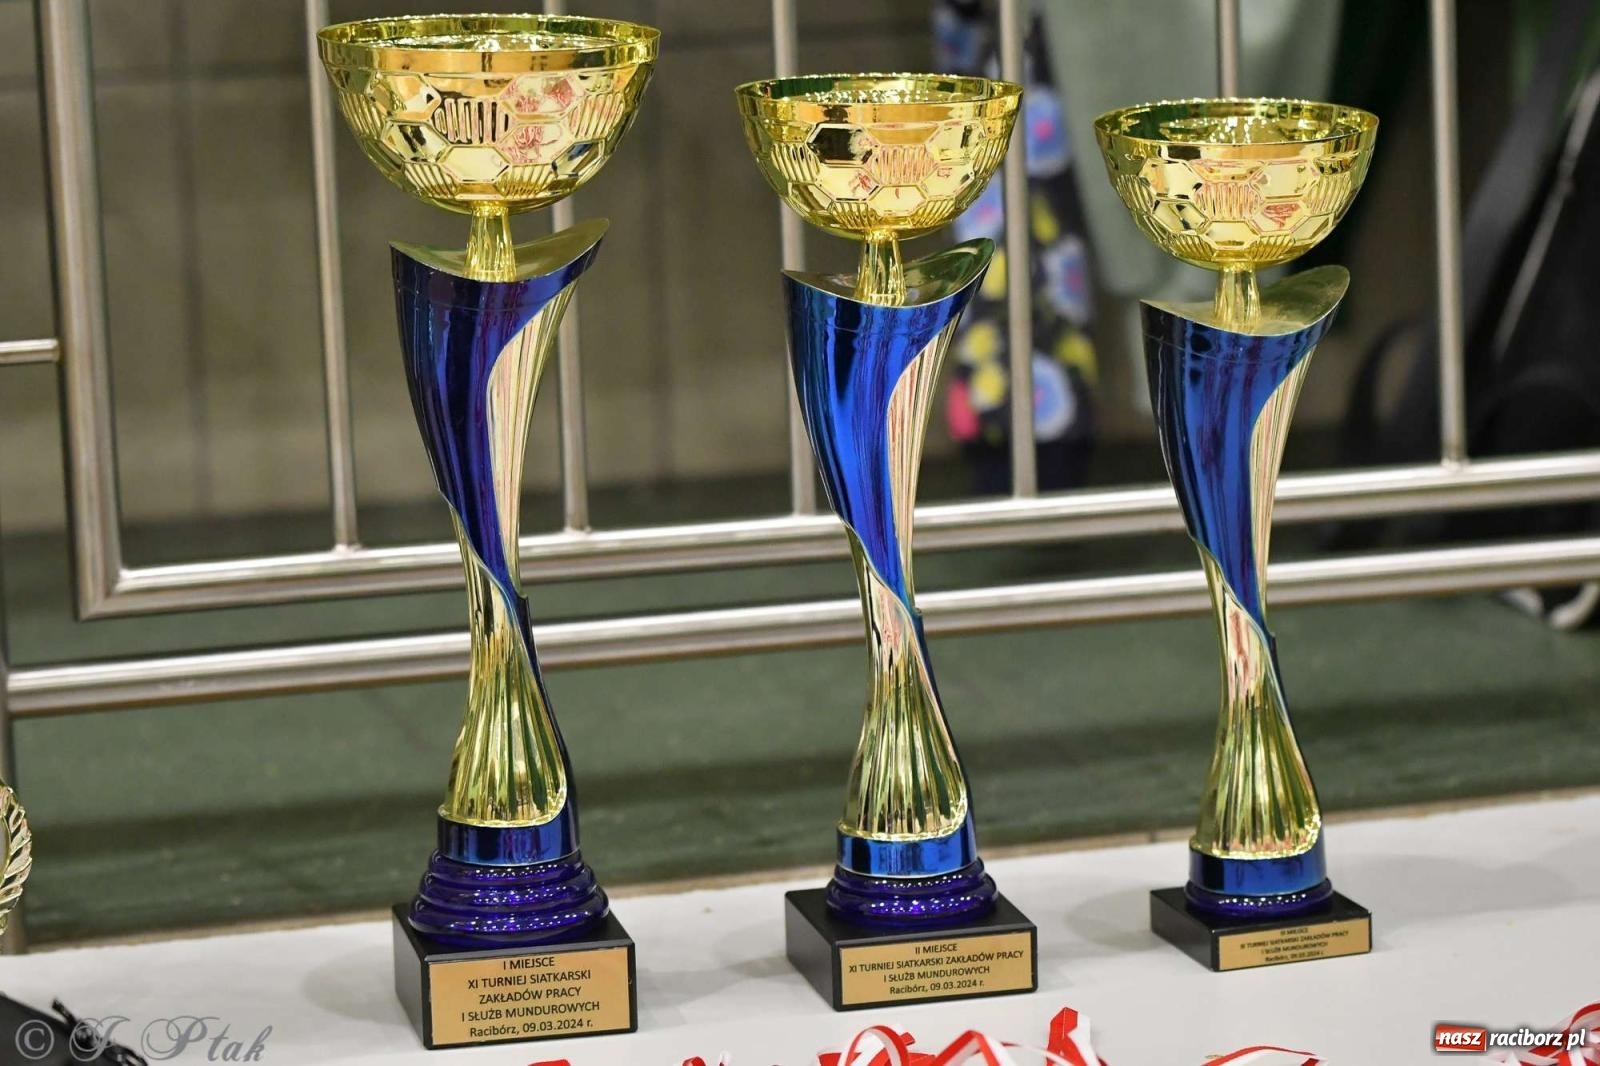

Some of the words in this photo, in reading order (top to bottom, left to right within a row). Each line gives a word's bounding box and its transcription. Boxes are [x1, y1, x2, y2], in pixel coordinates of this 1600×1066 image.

[915, 946, 920, 954] II
[923, 943, 958, 953] MIEJSCE
[510, 956, 555, 969] MIEJSCE
[849, 965, 857, 973] XI
[861, 962, 894, 971] TURNIEJ
[897, 957, 943, 969] SIATKARSKI
[946, 953, 994, 964] ZAKŁADÓW
[997, 951, 1023, 960] PRACY
[468, 978, 478, 989] XI
[482, 974, 527, 987] TURNIEJ
[530, 970, 591, 984] SIATKARSKI
[889, 972, 915, 982] SŁUŻB
[917, 966, 990, 979] MUNDUROWYCH
[479, 989, 542, 1004] ZAKŁADÓW
[546, 986, 581, 999] PRACY
[890, 984, 928, 994] Racibórz,
[930, 979, 977, 991] 09.03.2024
[468, 1008, 502, 1021] SŁUŻB
[506, 1001, 600, 1018] MUNDUROWYCH
[470, 1023, 519, 1037] Racibórz,
[523, 1018, 583, 1032] 09.03.2024
